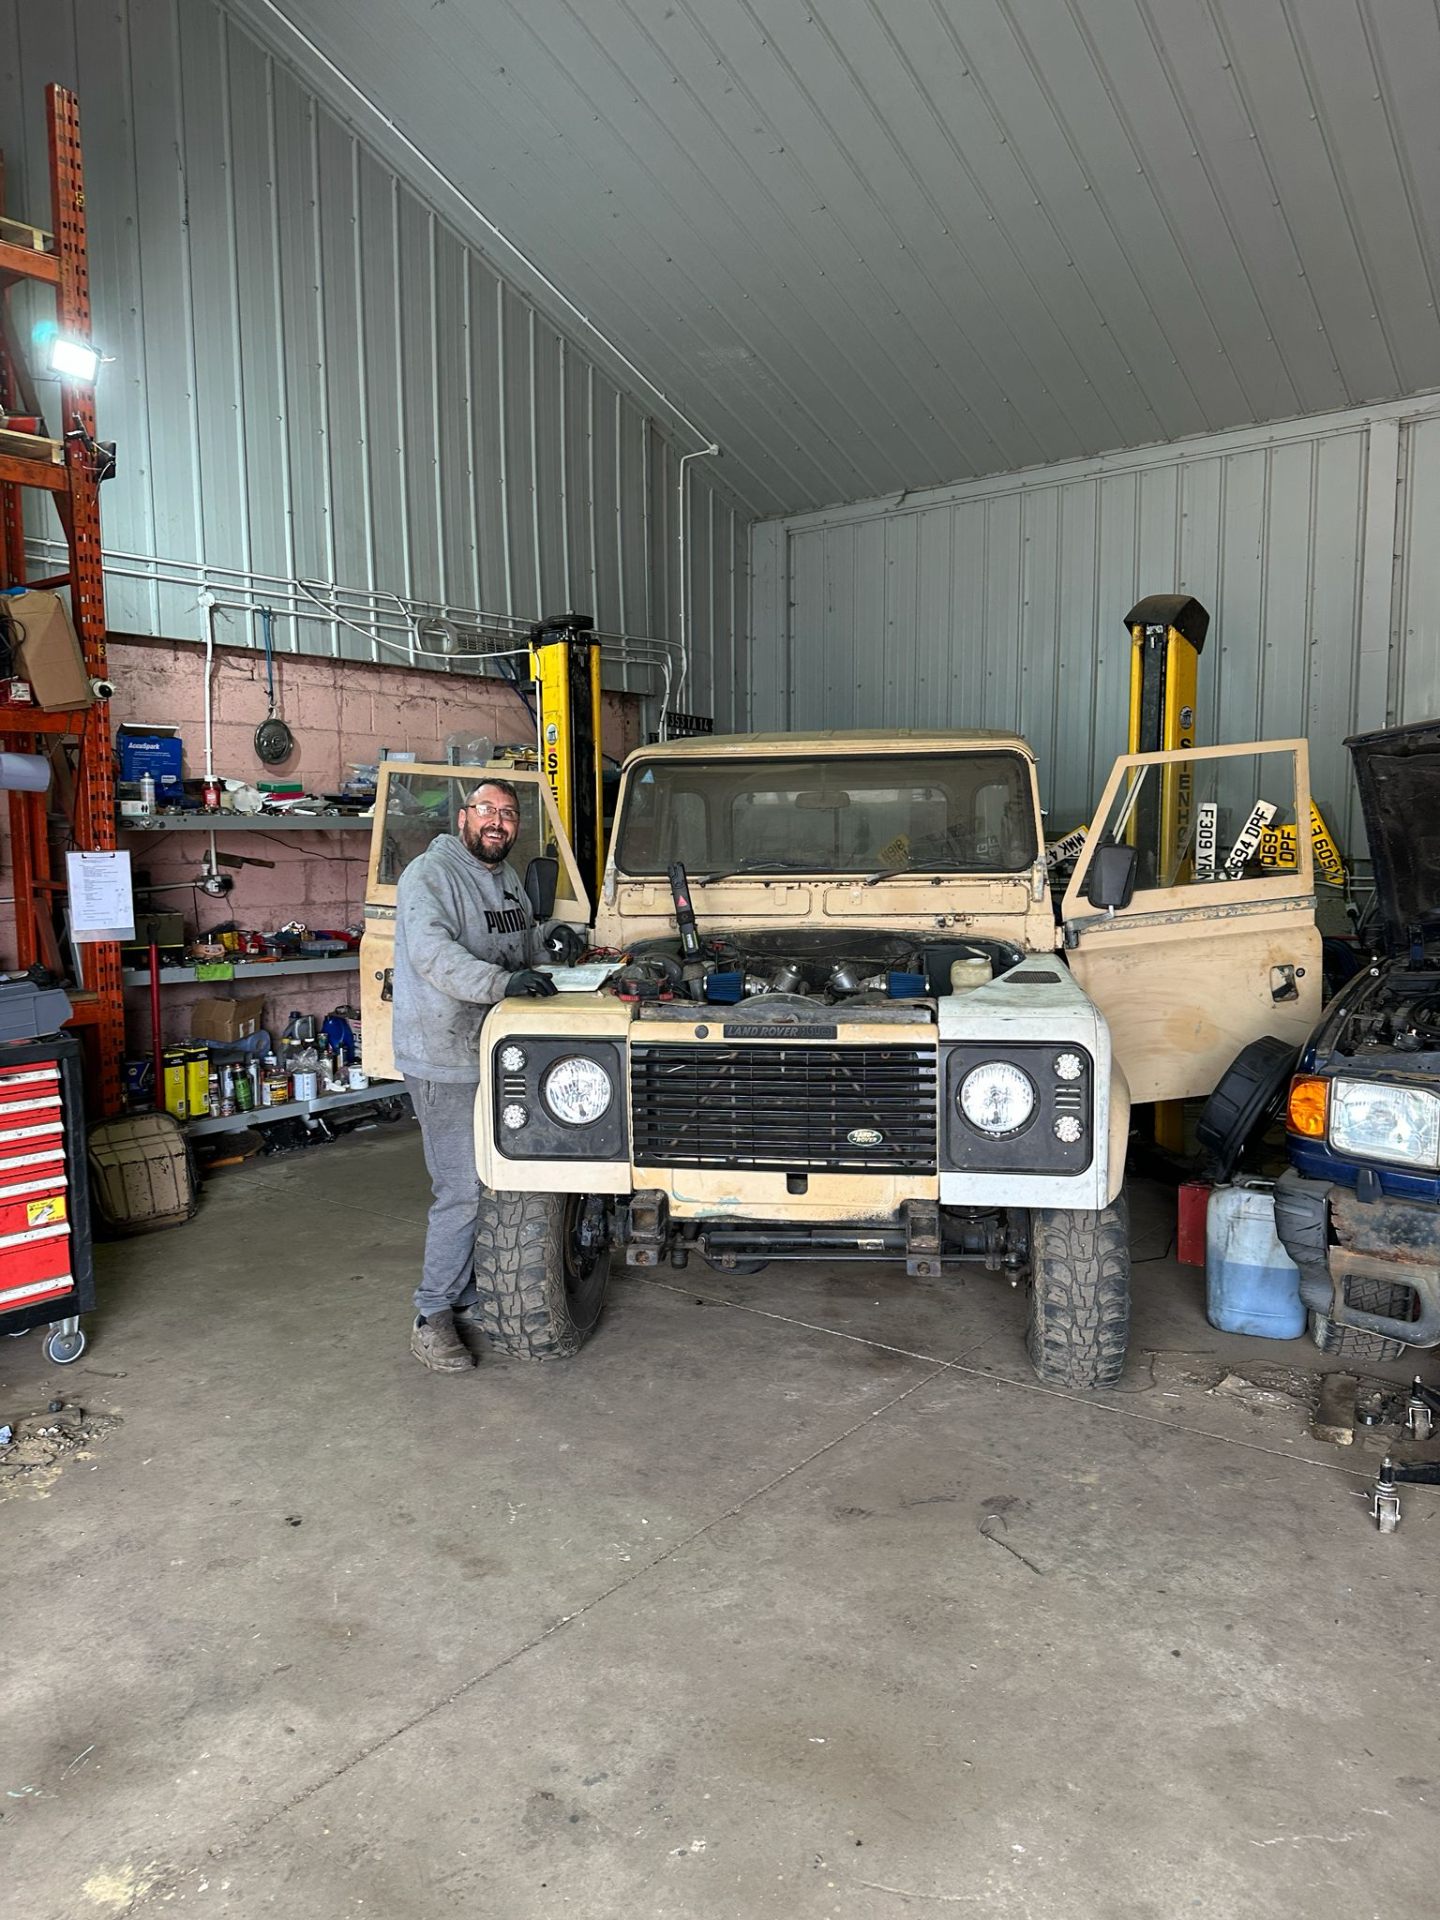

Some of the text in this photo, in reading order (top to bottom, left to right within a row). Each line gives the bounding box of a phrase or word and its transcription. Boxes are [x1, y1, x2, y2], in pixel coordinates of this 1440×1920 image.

[77, 192, 84, 205] 5
[1198, 809, 1214, 849] F309
[1245, 806, 1269, 839] DPF
[1279, 829, 1297, 863] DPF
[483, 908, 527, 934] PUMA
[727, 1026, 759, 1036] LAND
[760, 1026, 799, 1037] ROVER
